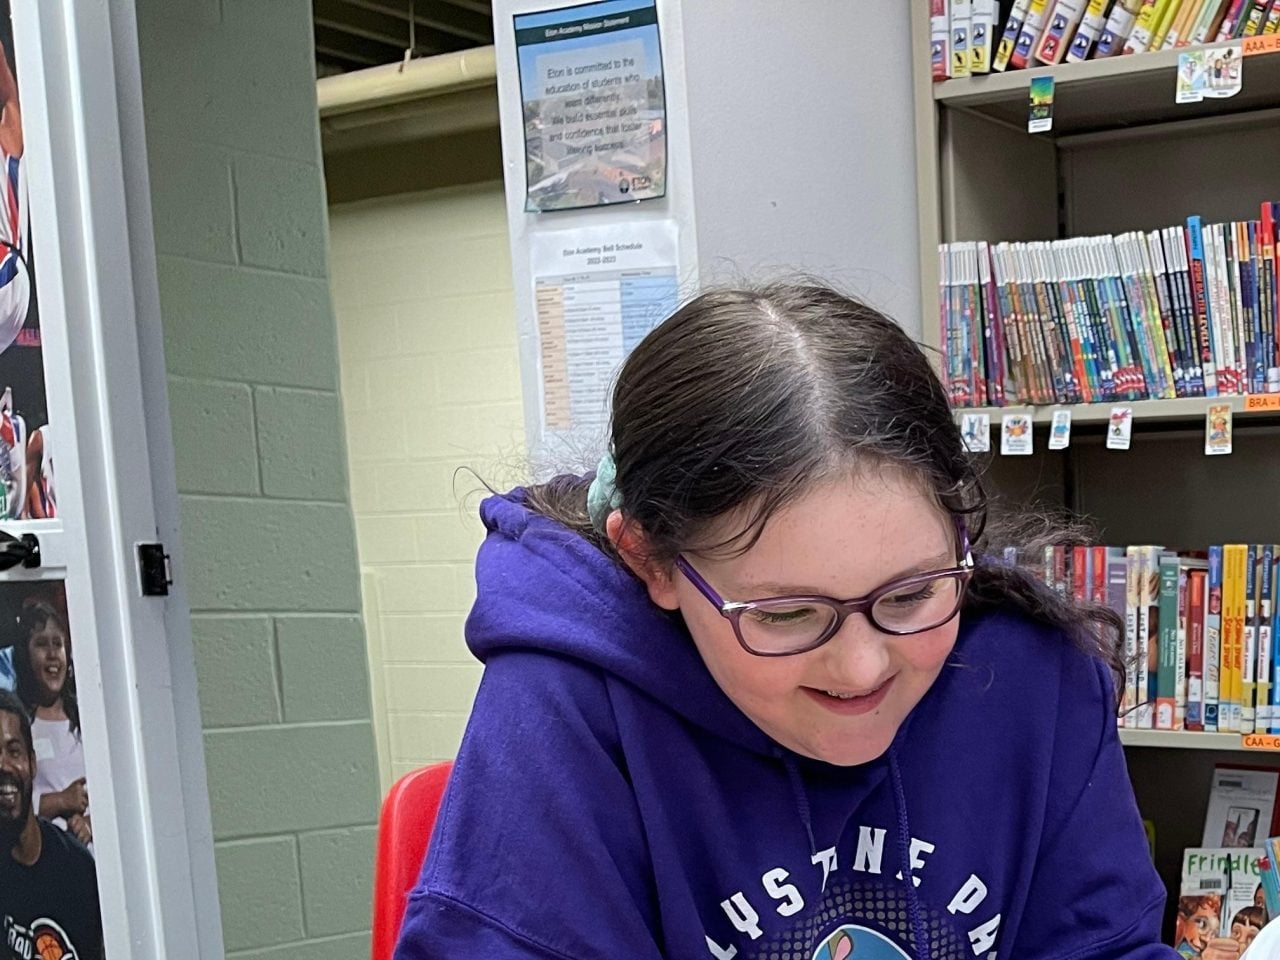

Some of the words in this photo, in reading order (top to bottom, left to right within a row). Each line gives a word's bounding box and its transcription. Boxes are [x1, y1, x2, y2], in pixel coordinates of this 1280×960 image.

[1245, 41, 1265, 51] AAA
[575, 61, 612, 75] committed
[615, 60, 621, 69] to
[545, 82, 580, 95] education
[592, 76, 621, 88] students
[1249, 398, 1268, 408] BRA
[1245, 737, 1264, 748] CAA
[1188, 853, 1262, 876] Frindle
